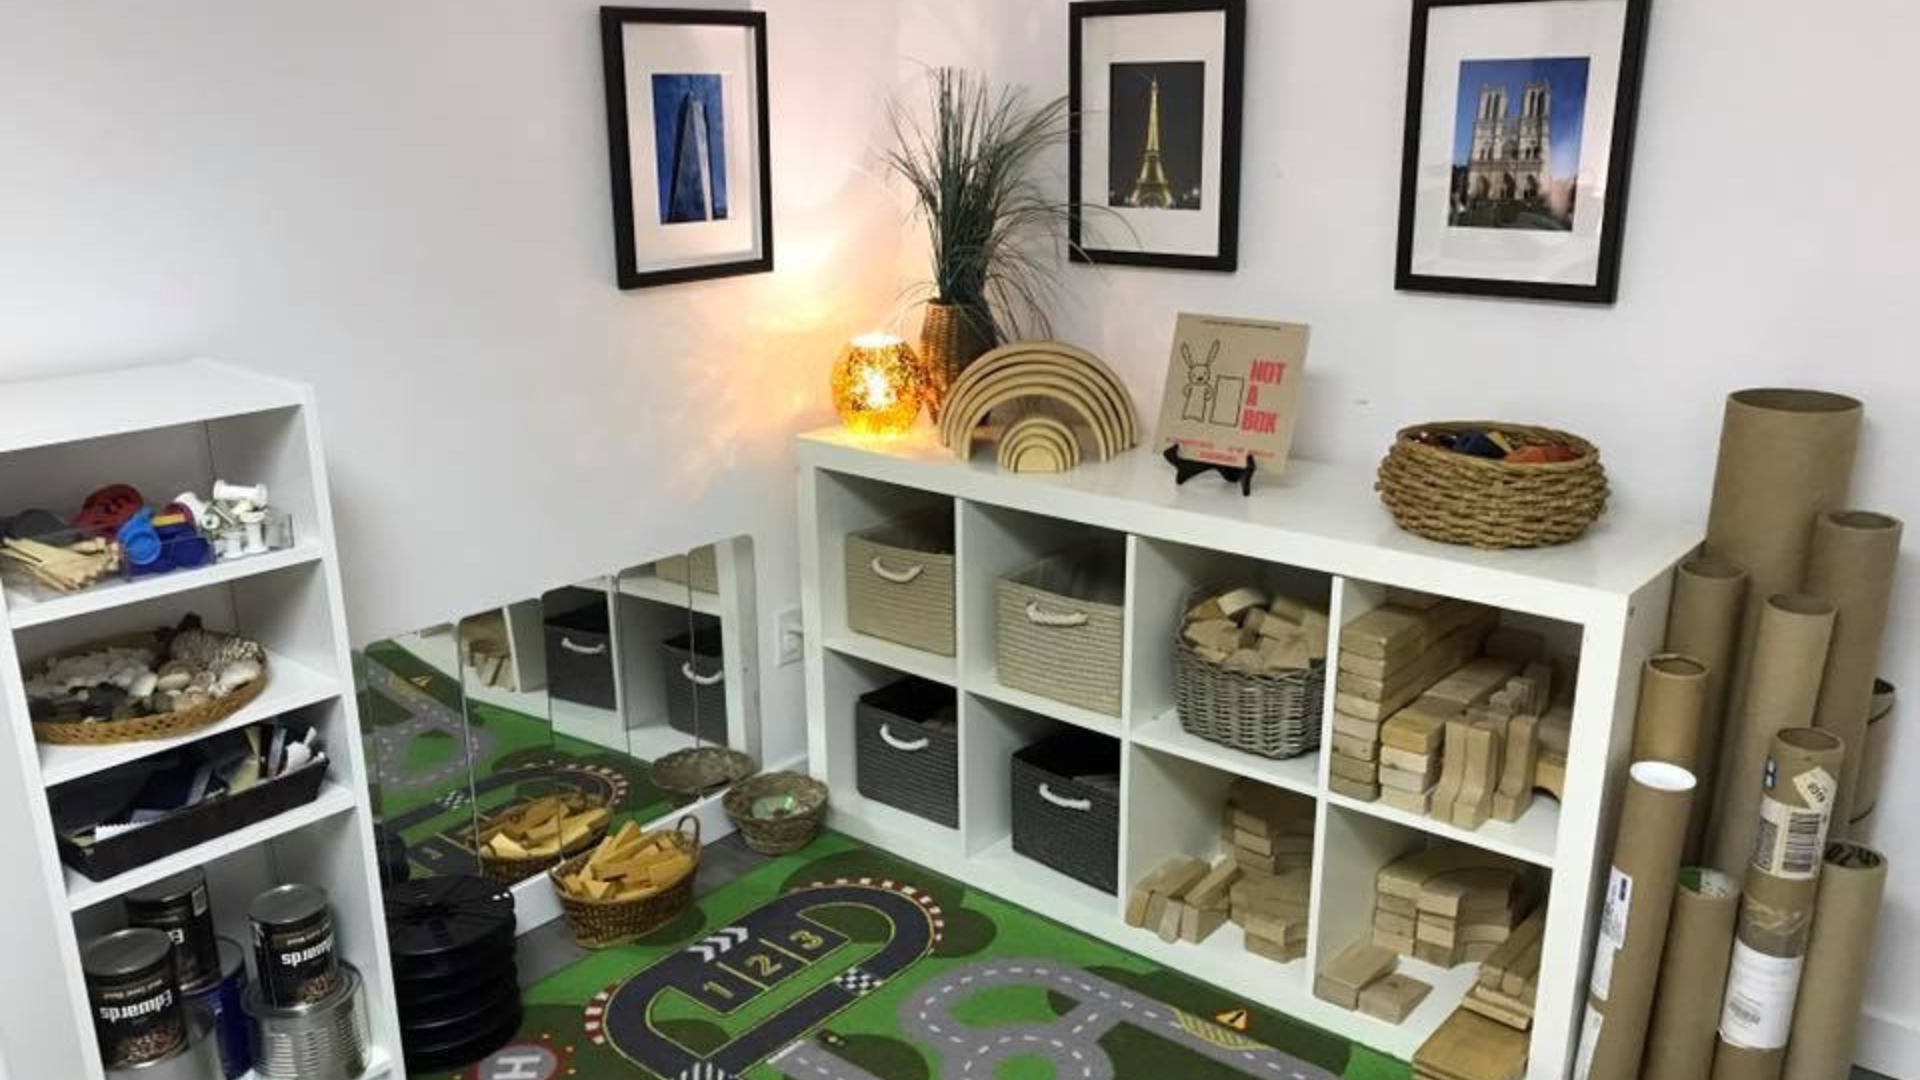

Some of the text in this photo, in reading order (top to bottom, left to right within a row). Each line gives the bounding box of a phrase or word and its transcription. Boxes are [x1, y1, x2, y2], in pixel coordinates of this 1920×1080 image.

[1250, 359, 1288, 385] NOT
[1246, 385, 1258, 407] A
[1242, 409, 1279, 435] BOX
[703, 929, 824, 998] 1 2 3
[99, 989, 173, 1023] Edwards
[493, 1055, 541, 1080] H
